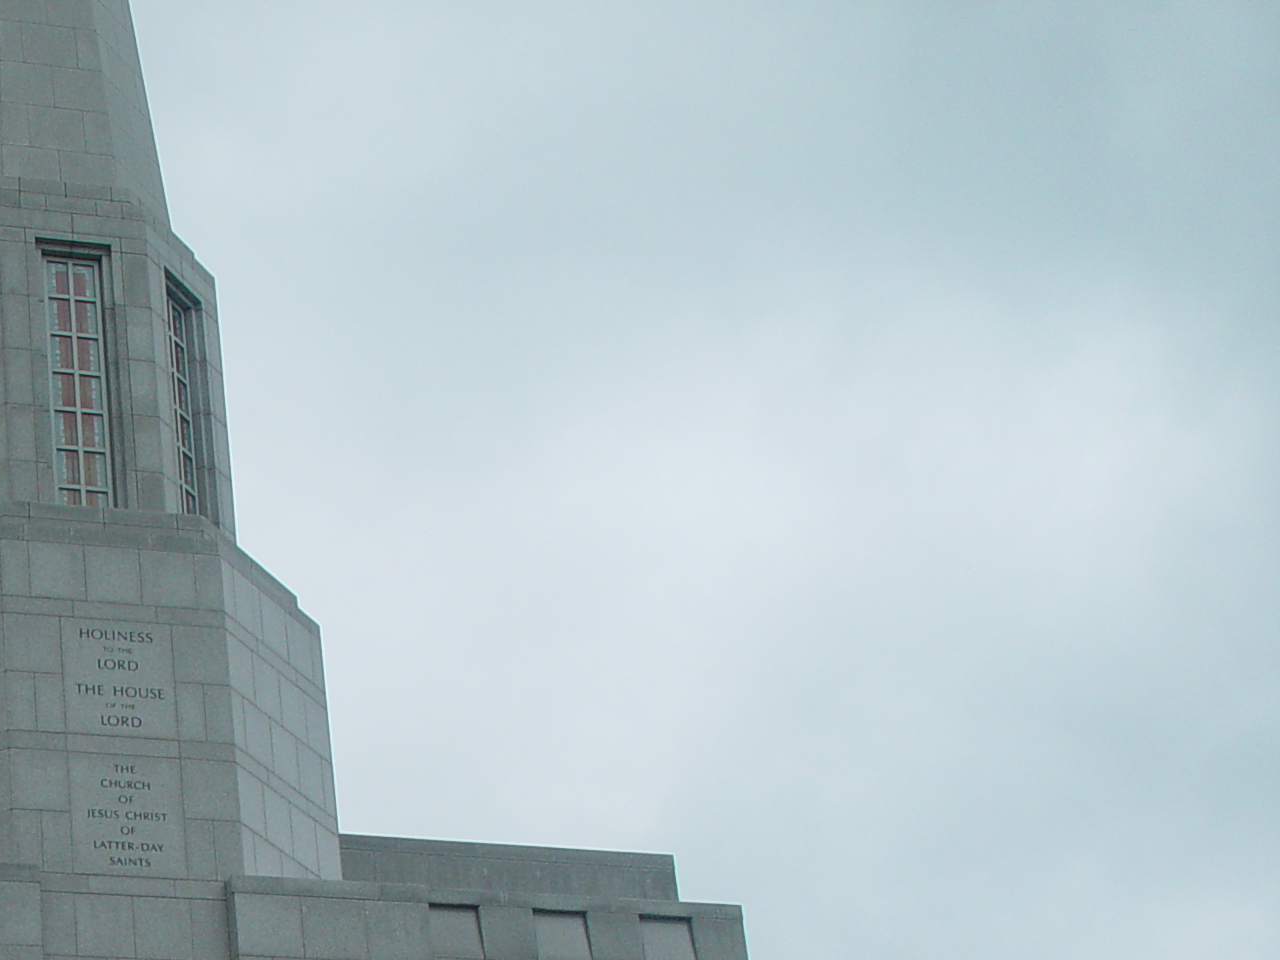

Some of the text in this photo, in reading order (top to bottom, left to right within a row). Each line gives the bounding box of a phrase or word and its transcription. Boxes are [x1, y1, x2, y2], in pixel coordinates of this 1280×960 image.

[79, 628, 154, 643] HOLINESS
[118, 647, 133, 655] THE
[97, 659, 139, 671] LORD
[76, 683, 165, 700] THE HOUSE
[100, 714, 142, 728] LORD
[114, 764, 136, 774] THE
[100, 778, 151, 790] CHURCH
[118, 795, 134, 804] OF
[87, 808, 167, 822] JESUS CHRIST
[120, 826, 136, 836] OF
[93, 840, 164, 853] LATTER-DAY
[109, 856, 151, 867] SAINTS
